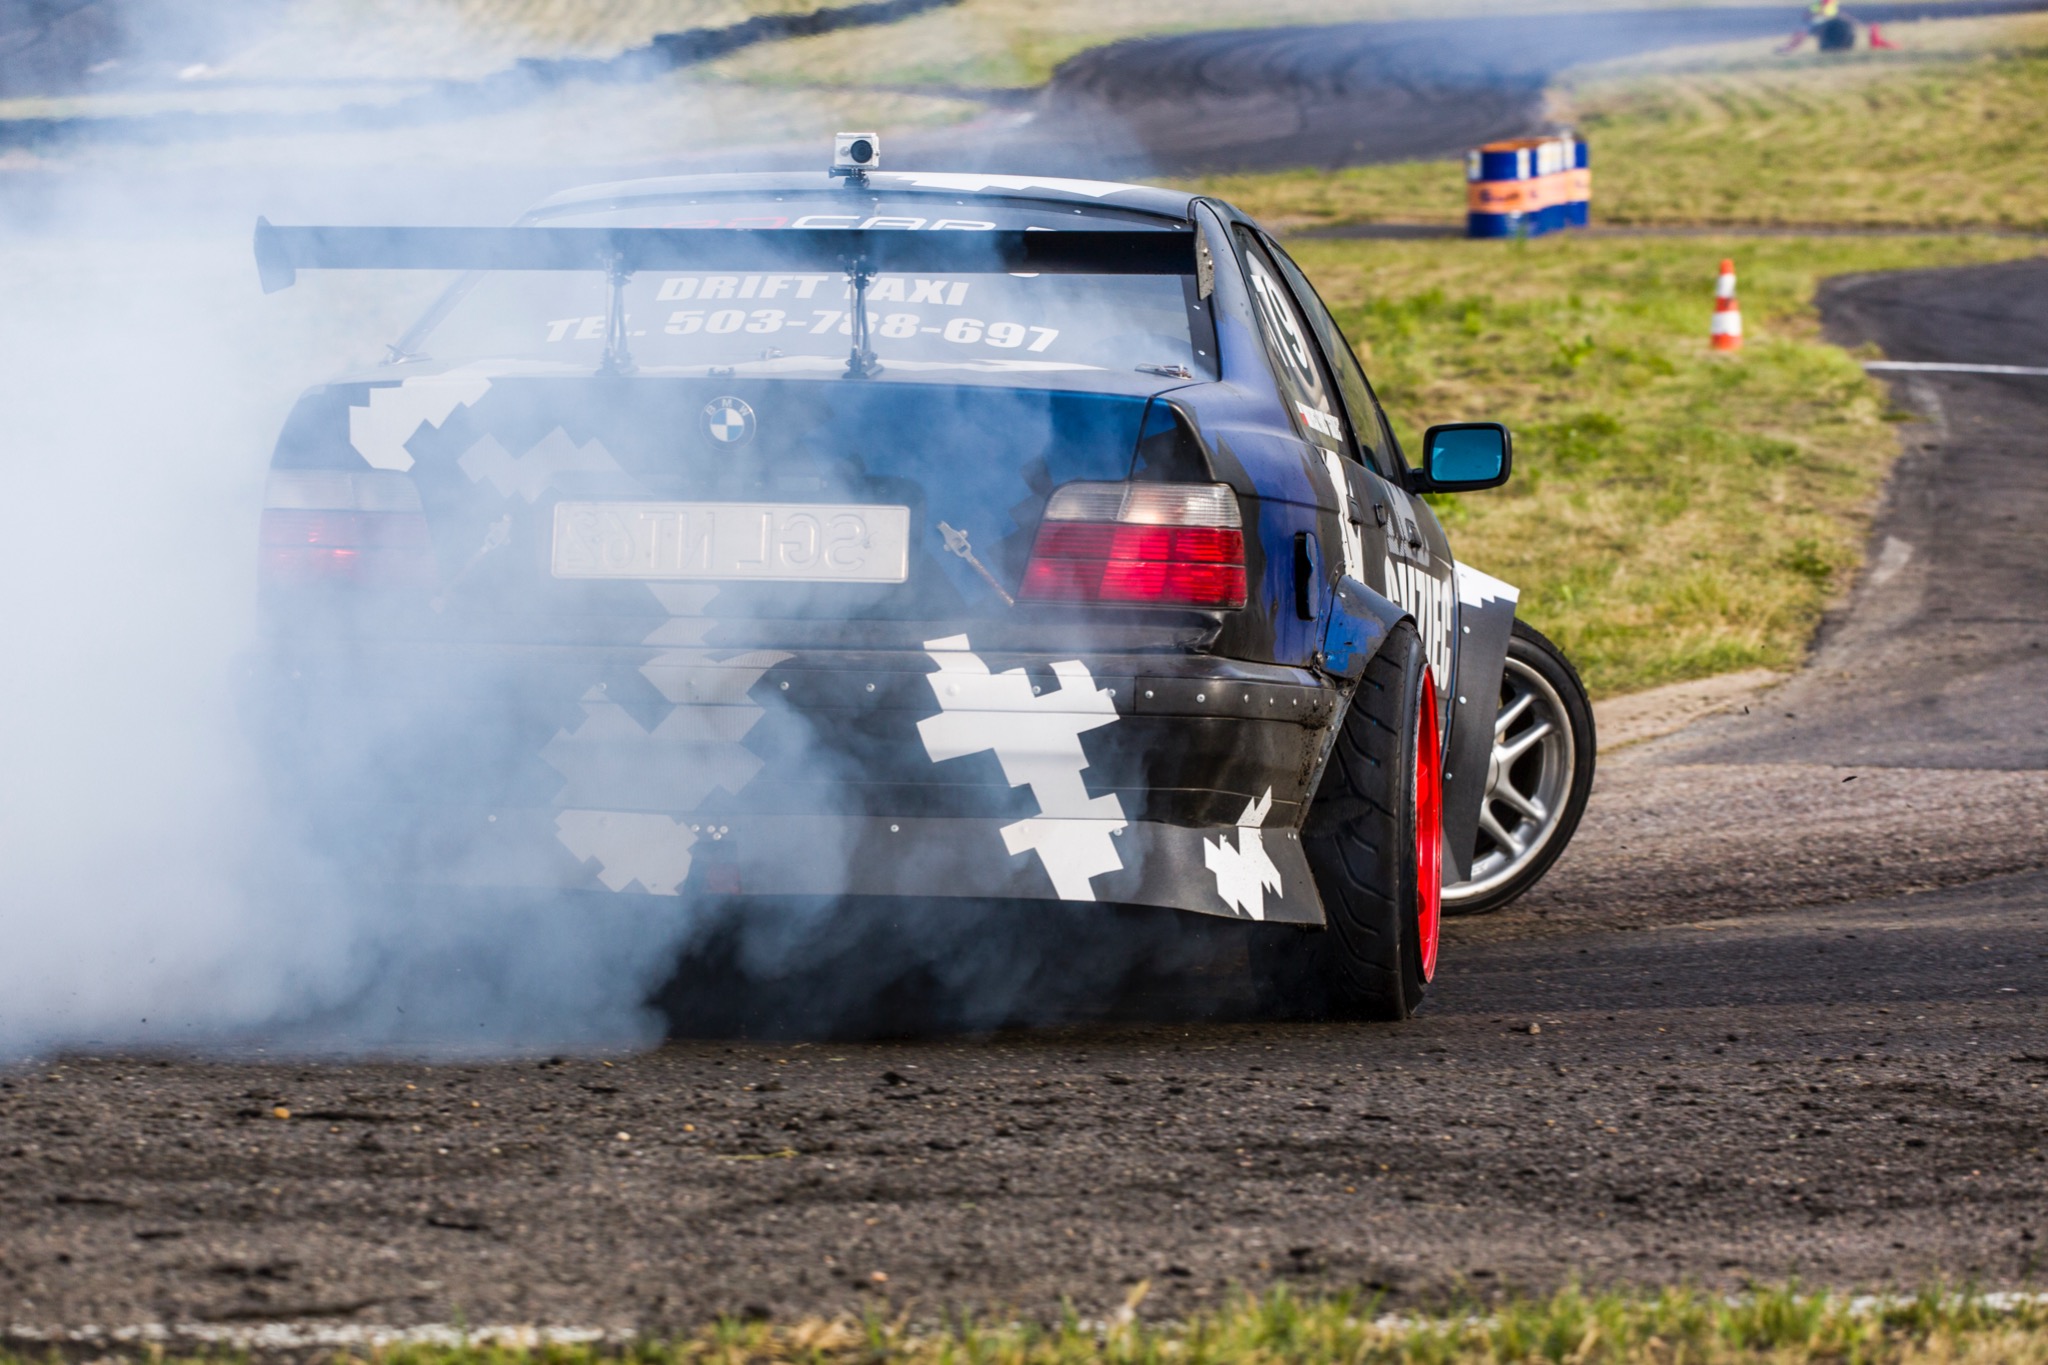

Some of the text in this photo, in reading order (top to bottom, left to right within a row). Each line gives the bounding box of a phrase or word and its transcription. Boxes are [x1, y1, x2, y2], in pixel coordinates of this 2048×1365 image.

[656, 273, 970, 306] DRIFT TAXI
[664, 309, 1059, 352] 503-788-697
